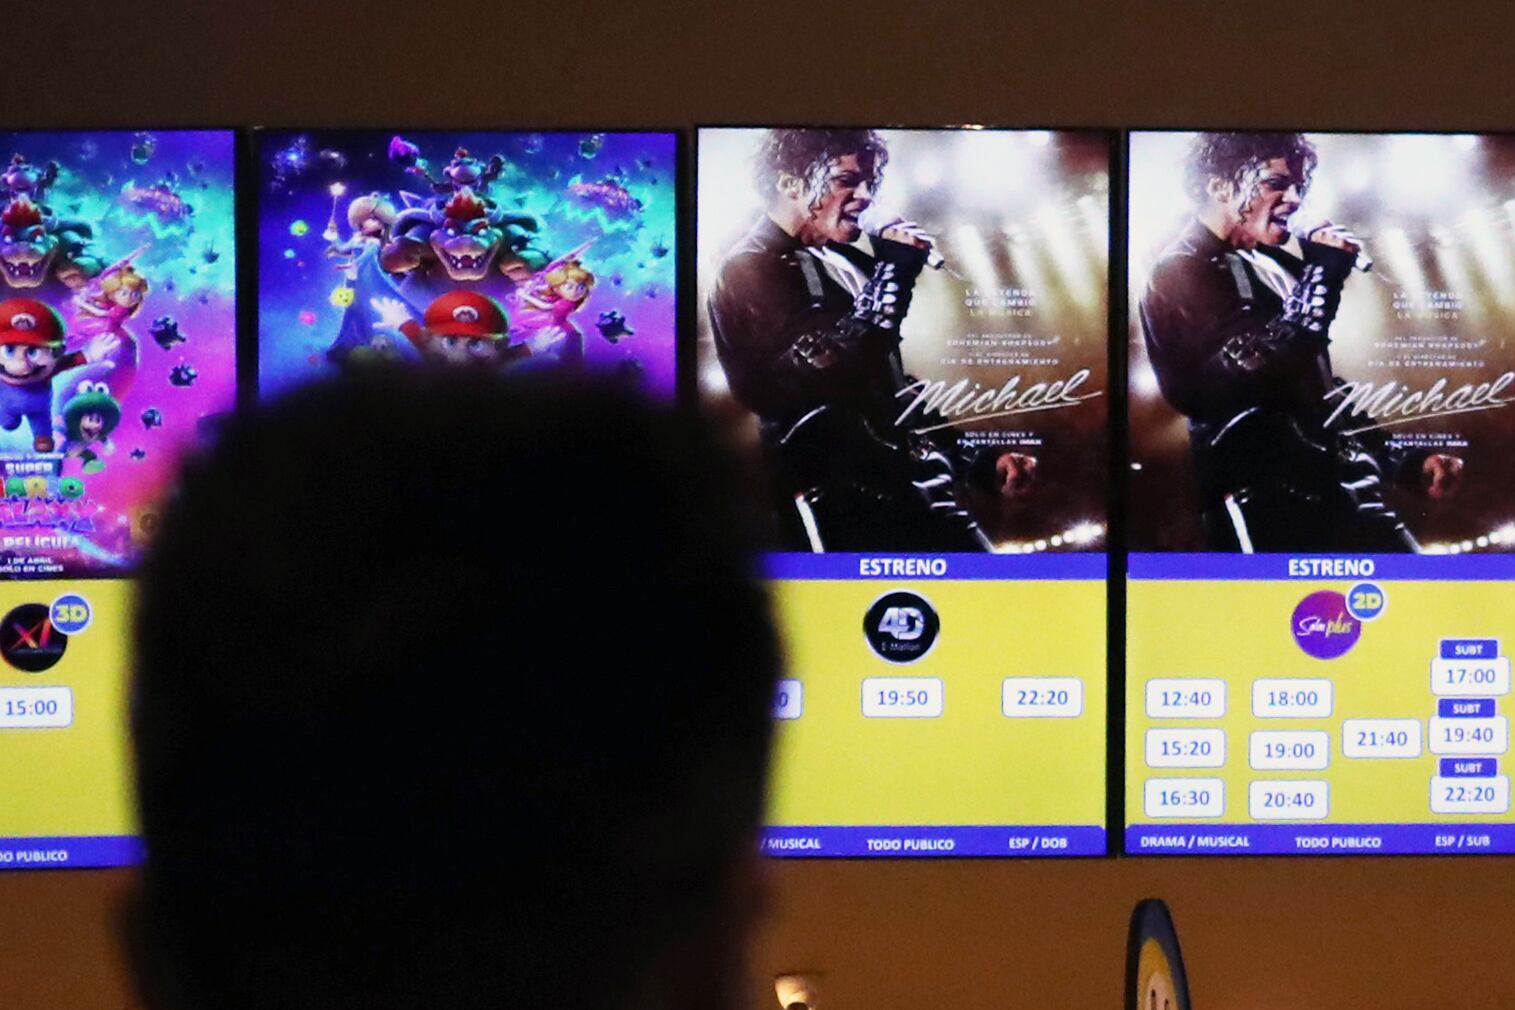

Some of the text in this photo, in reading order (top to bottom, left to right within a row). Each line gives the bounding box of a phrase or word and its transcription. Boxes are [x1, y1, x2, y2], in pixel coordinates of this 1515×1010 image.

[894, 368, 1103, 427] Michael
[859, 558, 947, 576] ESTRENO
[1288, 558, 1375, 577] ESTRENO
[1352, 591, 1382, 610] 2D
[878, 606, 926, 641] 4D
[1454, 644, 1483, 656] SUBT
[1445, 668, 1497, 684] 17:00
[877, 689, 929, 707] 19:50
[1017, 689, 1069, 706] 22:20
[1161, 691, 1212, 707] 12:40
[1267, 691, 1319, 707] 18:00
[6, 700, 57, 716] 15:00
[1452, 702, 1481, 714] SUBT
[1357, 731, 1408, 747] 21:40
[1443, 727, 1494, 743] 19:40
[1160, 740, 1211, 757] 15:20
[1264, 743, 1315, 759] 19:00
[1454, 762, 1482, 773] SUBT
[1160, 790, 1210, 806] 16:30
[1263, 792, 1315, 808] 20:40
[1444, 786, 1495, 802] 22:20
[768, 837, 821, 850] MUSICAL
[866, 839, 900, 851] TODO
[903, 839, 955, 851] PUBLICO
[1008, 837, 1029, 849] ESP
[1140, 836, 1187, 848] DRAMA
[1196, 836, 1250, 848] MUSICAL
[1295, 836, 1328, 848] TODO
[1331, 836, 1382, 848] PUBLICO
[1435, 835, 1456, 847] ESP
[1466, 835, 1490, 848] SUB
[16, 851, 68, 862] PUBLICO
